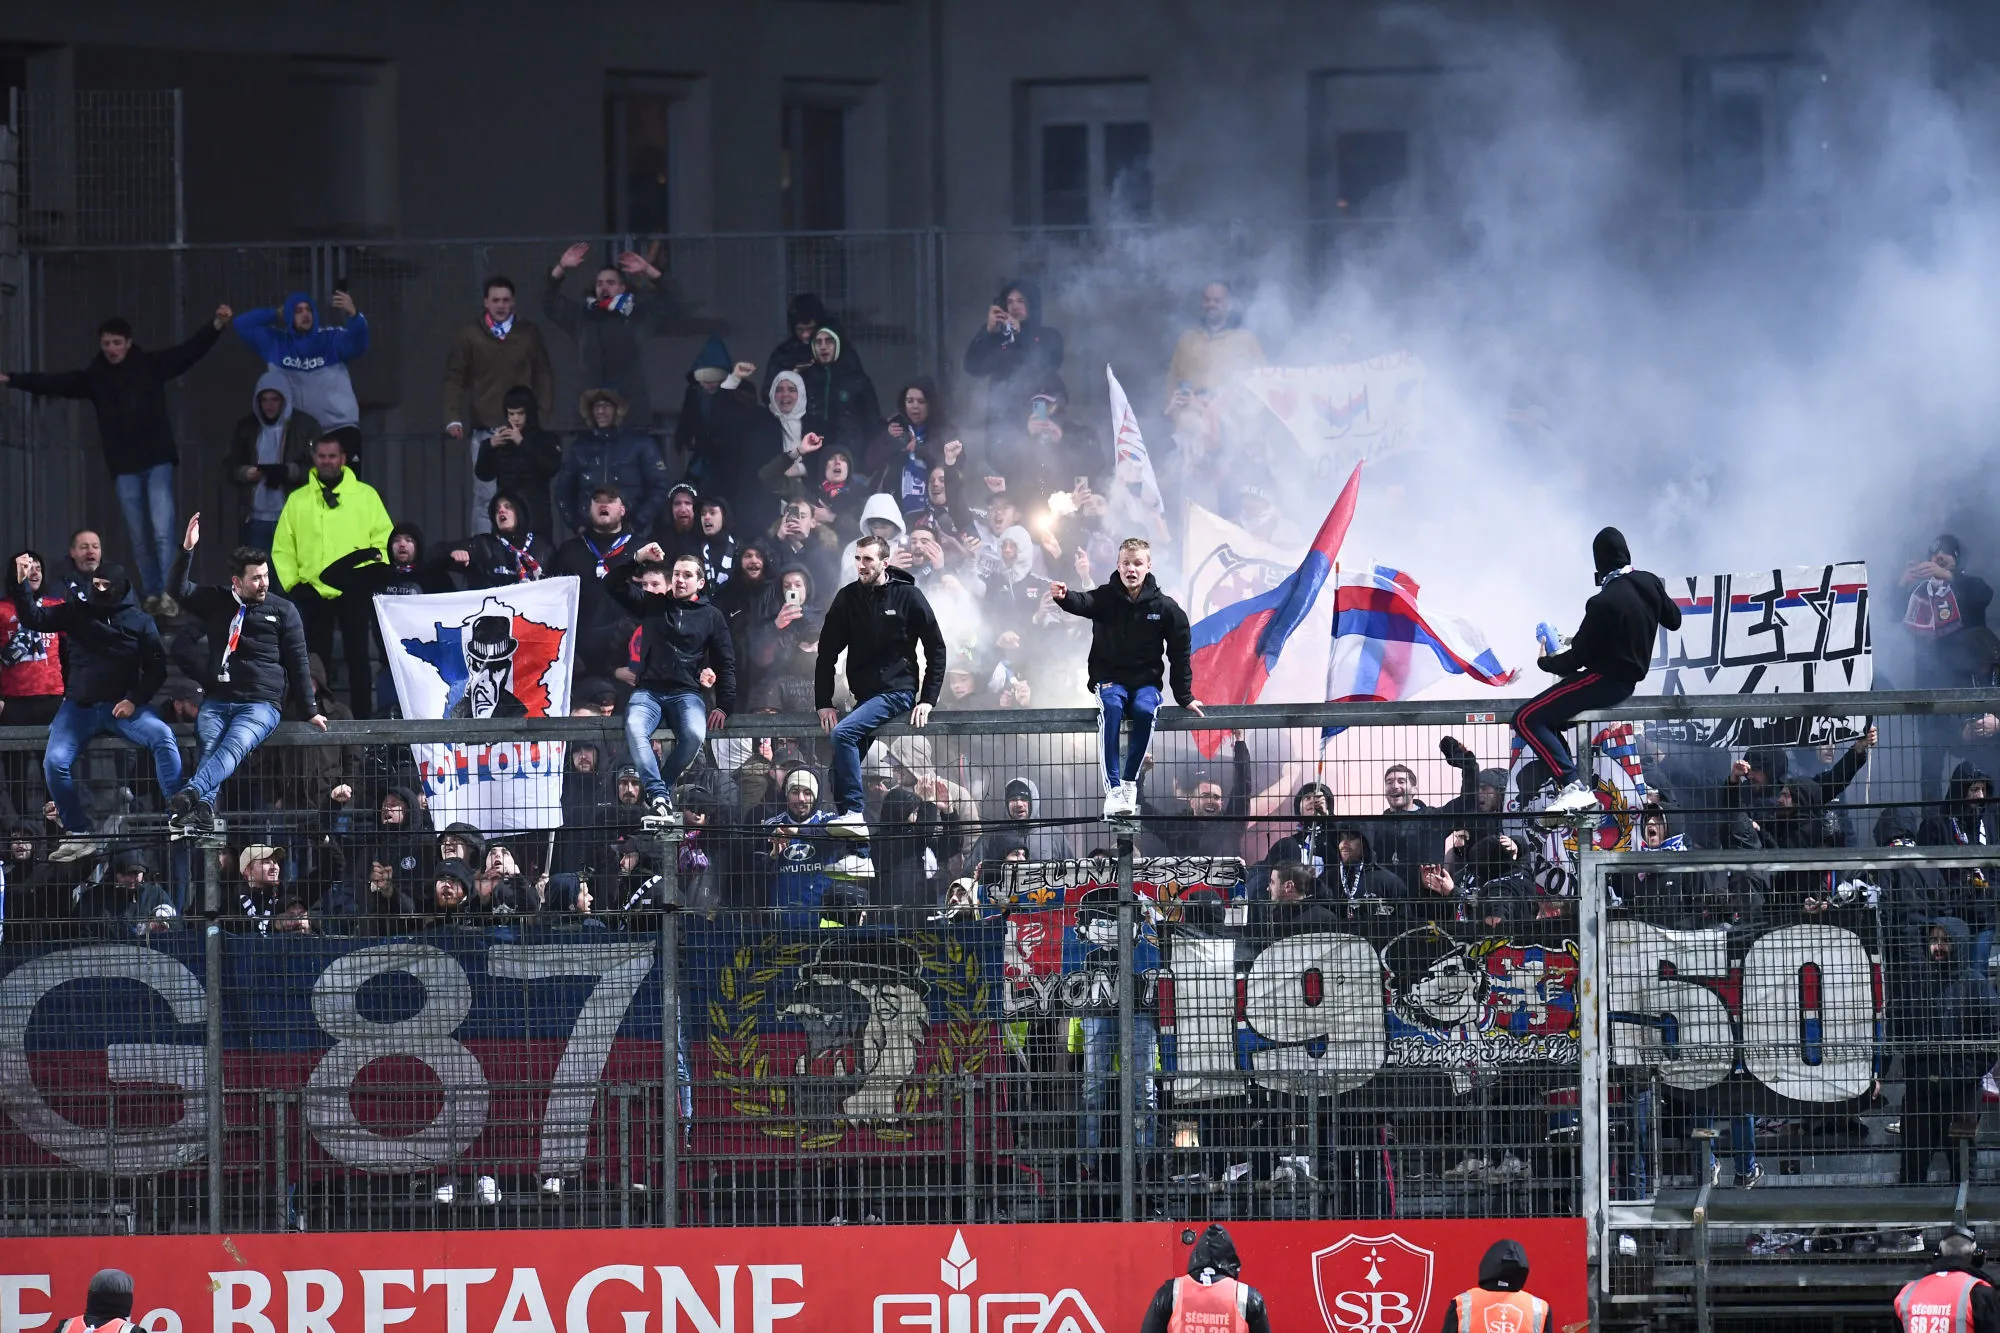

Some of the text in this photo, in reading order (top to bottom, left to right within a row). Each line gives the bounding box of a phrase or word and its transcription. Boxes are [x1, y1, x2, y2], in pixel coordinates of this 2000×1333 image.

[282, 356, 325, 370] adidas
[987, 856, 1241, 900] JEUNESSE
[306, 941, 656, 1175] 87
[207, 1264, 806, 1333] BRETAGNE
[1334, 1291, 1414, 1328] SB
[1911, 1303, 1952, 1316] SÉCURITÉ
[1185, 1310, 1230, 1325] SÉCURITÉ
[1910, 1316, 1951, 1333] SB 29
